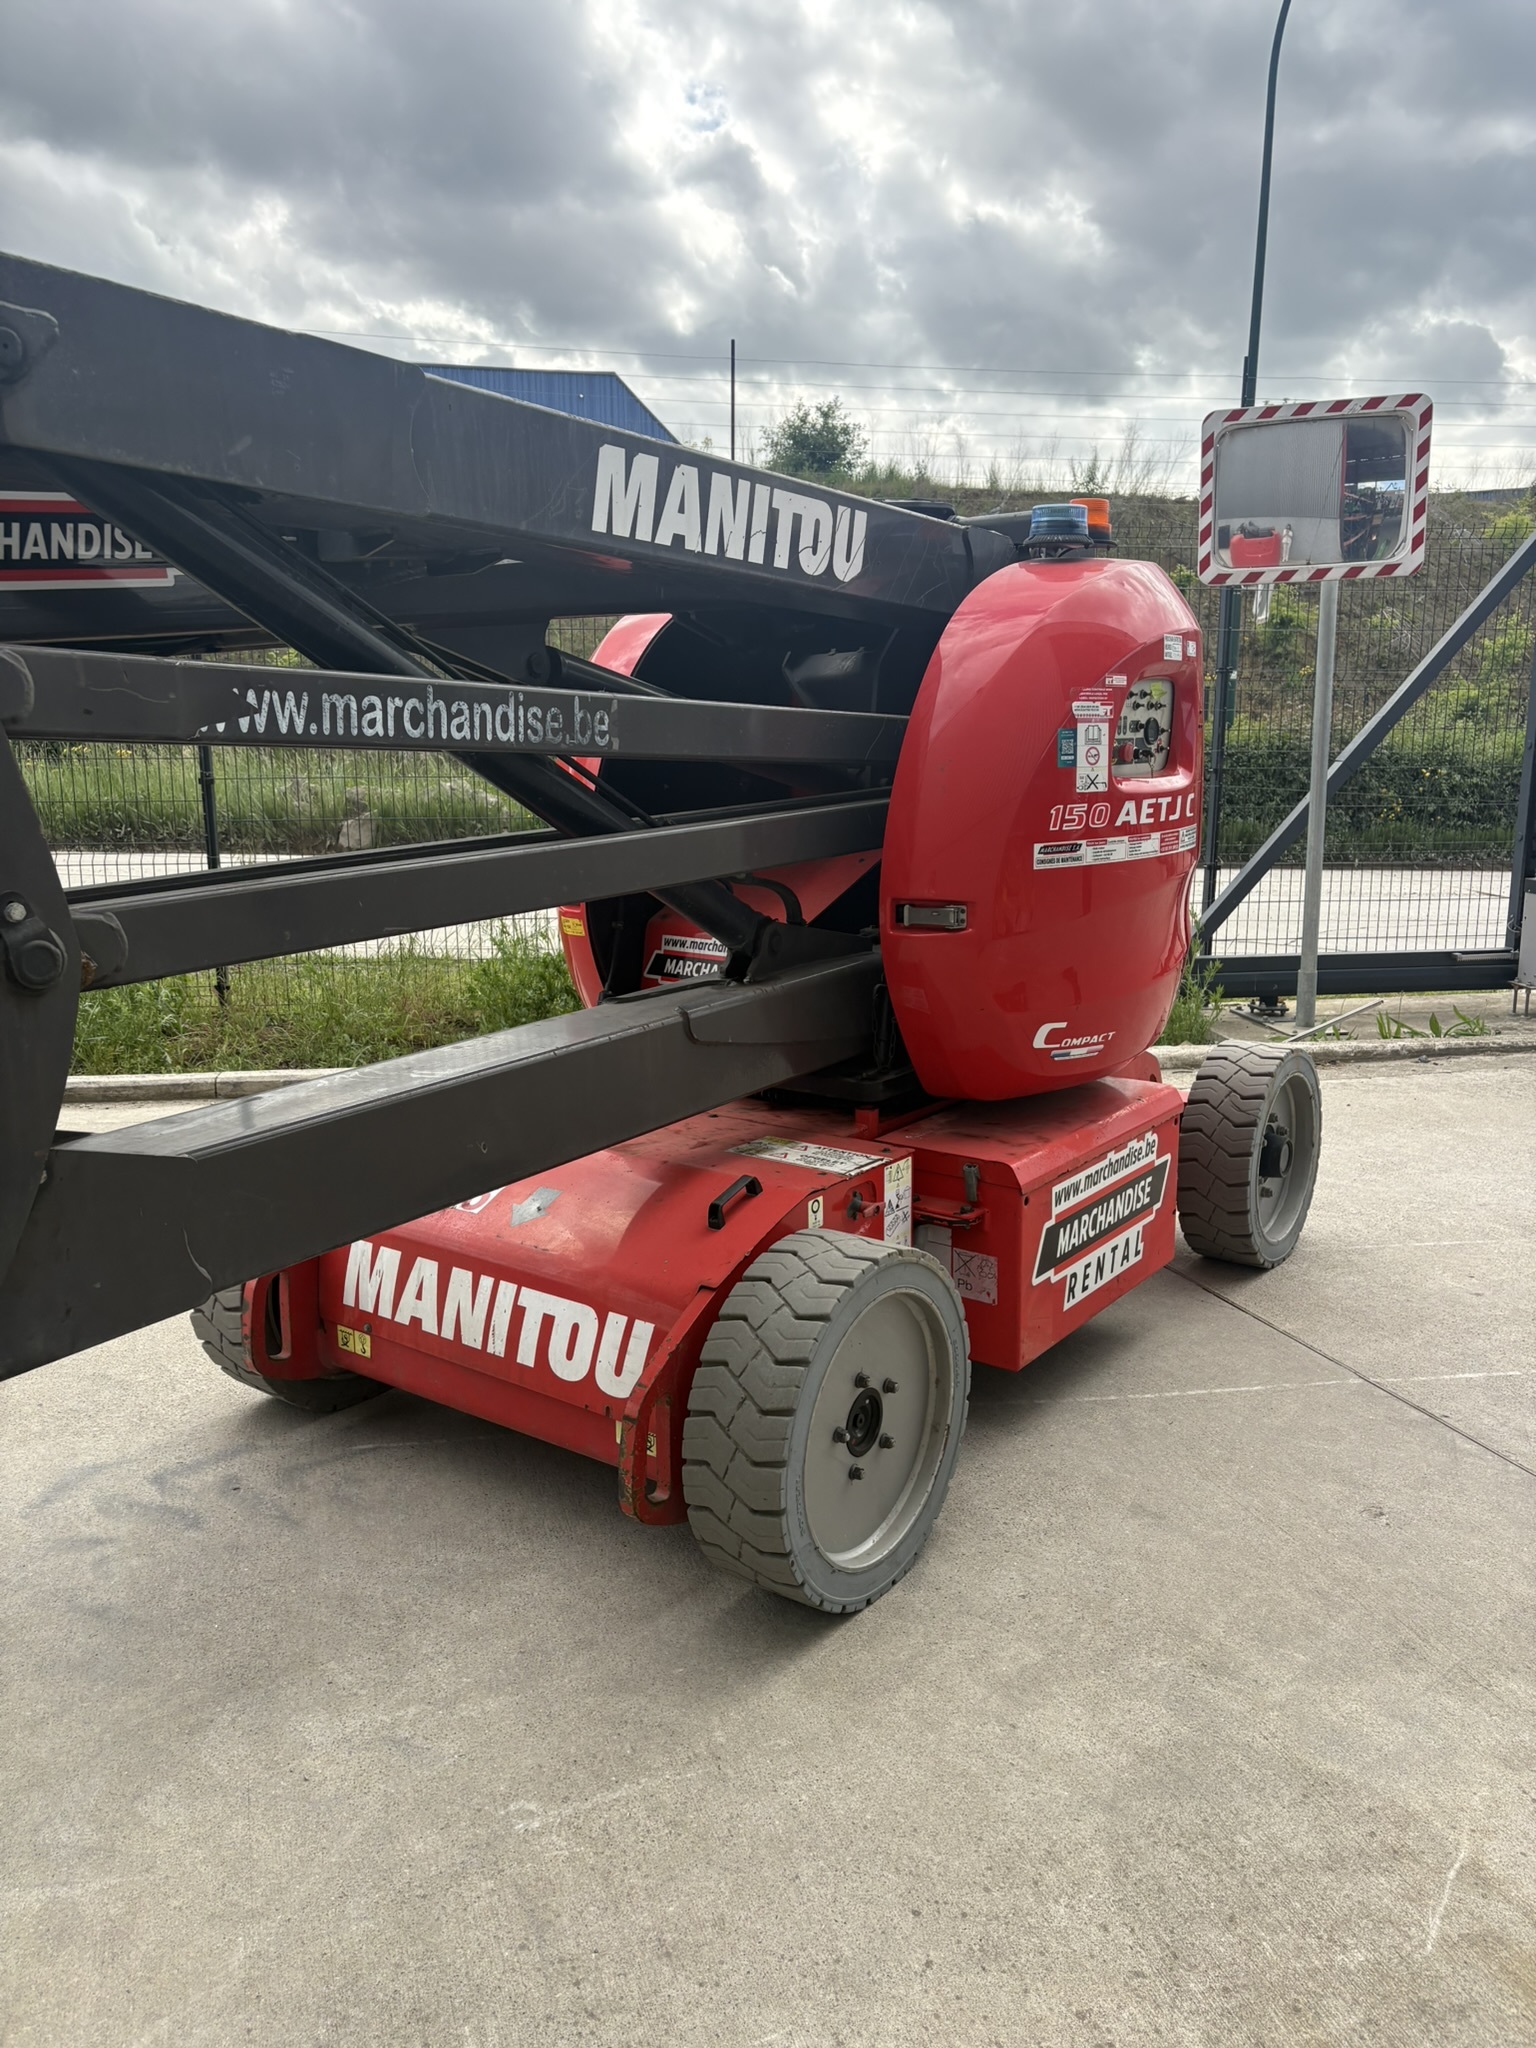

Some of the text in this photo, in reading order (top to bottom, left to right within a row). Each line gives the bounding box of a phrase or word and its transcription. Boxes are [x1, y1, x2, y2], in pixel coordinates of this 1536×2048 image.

[592, 443, 868, 583] MANITOU
[1049, 802, 1111, 831] 150
[1054, 1137, 1156, 1208] www.marchandise.be
[1056, 1175, 1153, 1259] MARCHANDISE
[957, 1278, 973, 1291] Pb
[1066, 1229, 1142, 1304] RENTAL
[343, 1239, 655, 1399] MANITOU
